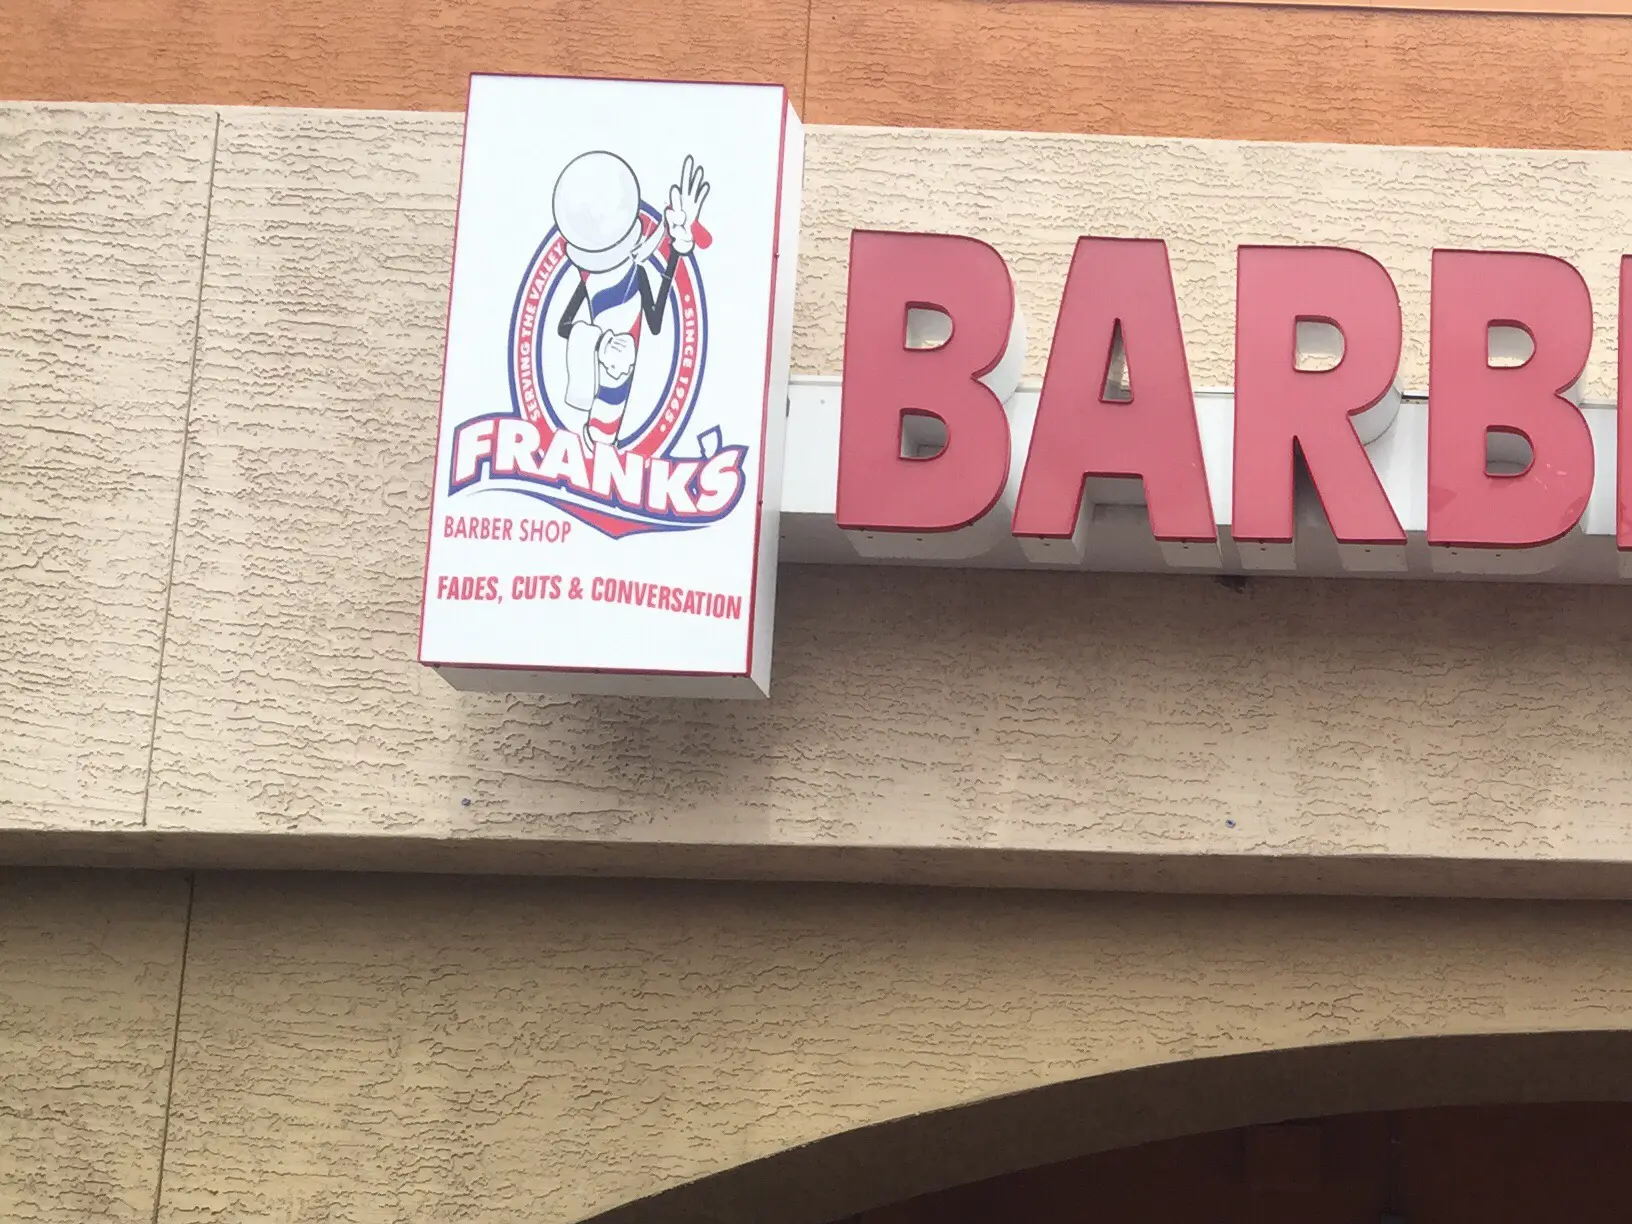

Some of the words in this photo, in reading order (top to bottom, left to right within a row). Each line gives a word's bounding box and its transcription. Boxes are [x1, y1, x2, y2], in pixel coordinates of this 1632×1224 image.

[530, 241, 564, 299] VALLEY
[522, 301, 538, 337] THE
[682, 308, 696, 370] SINCE
[519, 343, 542, 422] SERVING
[664, 376, 690, 423] 1965
[449, 415, 749, 515] FRANK'S
[444, 515, 513, 540] BARBER
[519, 518, 572, 543] SHOP
[436, 575, 503, 604] FADES,
[511, 575, 562, 600] CUTS
[567, 576, 583, 600] &
[591, 576, 743, 620] CONVERSATION
